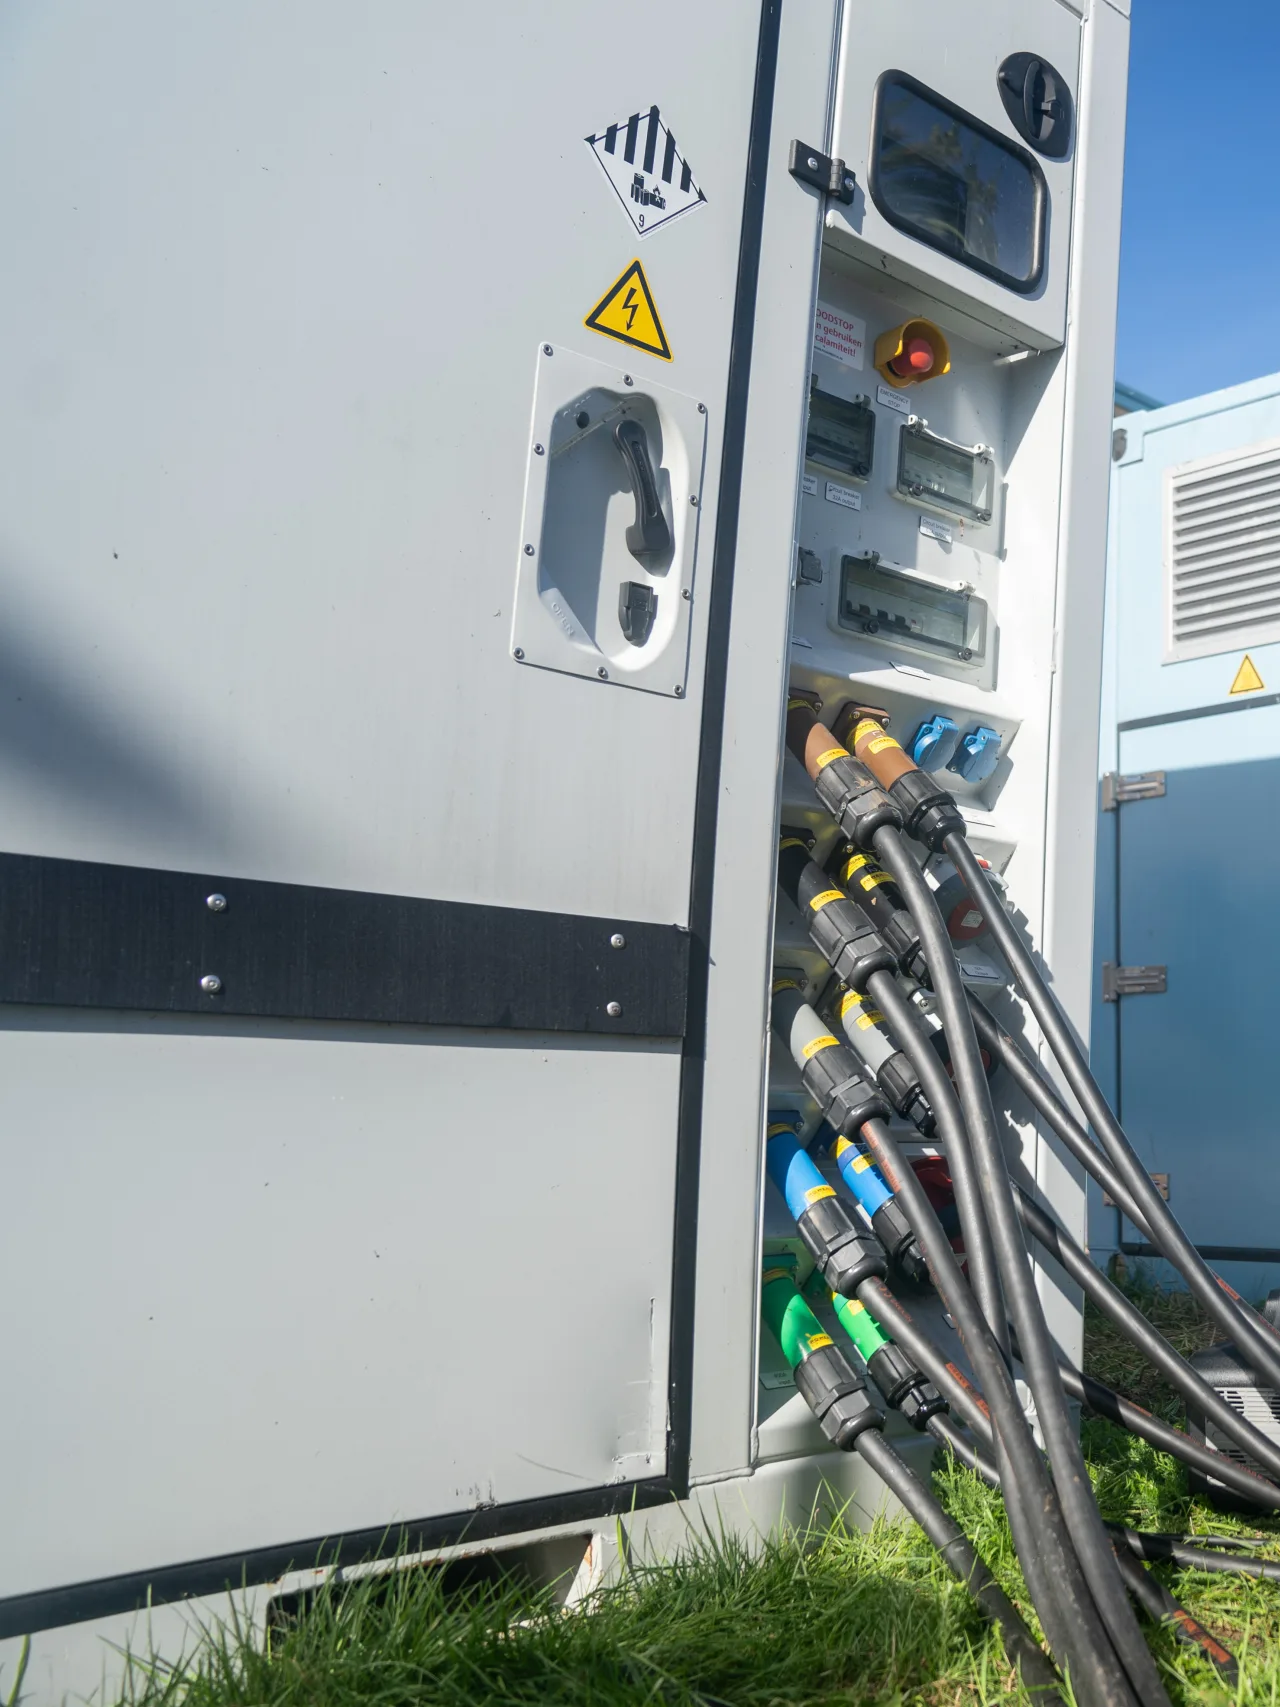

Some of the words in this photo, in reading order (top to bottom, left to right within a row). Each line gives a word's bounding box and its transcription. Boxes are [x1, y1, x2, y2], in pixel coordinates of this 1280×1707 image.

[638, 213, 645, 228] 9
[823, 326, 862, 348] gebruiken
[815, 334, 856, 357] calamiteit!
[880, 388, 909, 405] EMERGENCY
[887, 399, 901, 408] STOP
[843, 490, 860, 500] breaker
